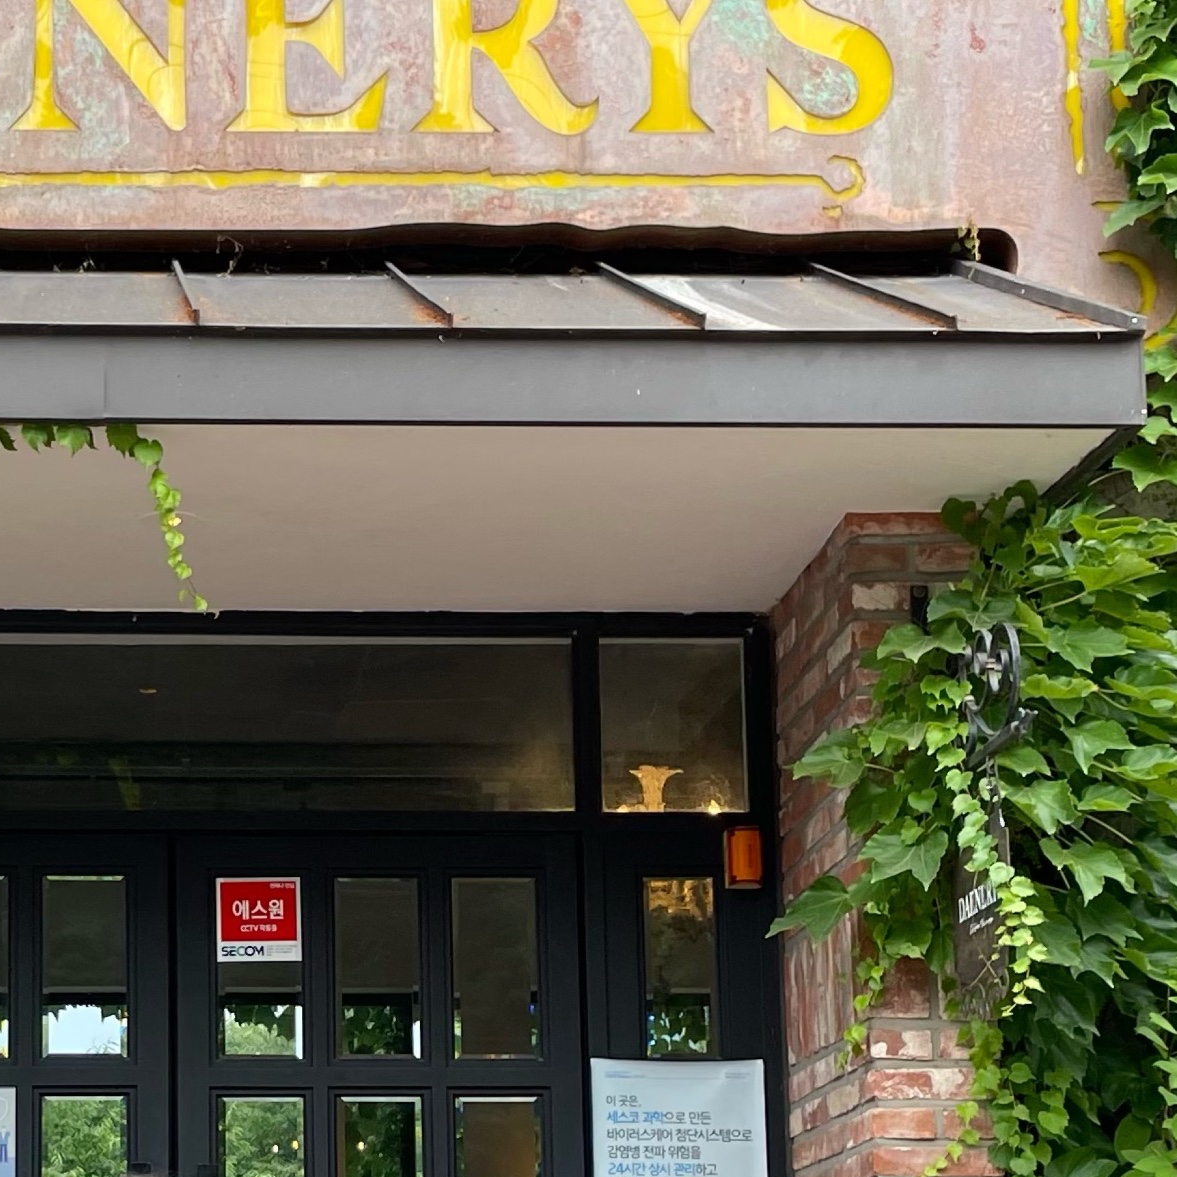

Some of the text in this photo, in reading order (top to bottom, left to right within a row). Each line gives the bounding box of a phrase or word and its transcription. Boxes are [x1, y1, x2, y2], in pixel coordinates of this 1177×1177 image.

[232, 899, 284, 920] 에스원
[240, 924, 259, 932] CCTV
[221, 945, 265, 957] SECOM
[606, 1095, 617, 1107] 이
[607, 1111, 712, 1125] 세스코 과학으로 만든
[607, 1128, 753, 1142] 바이러스케어 첨단시스템으로
[608, 1145, 701, 1160] 감염병 전파 위험을
[608, 1162, 718, 1177] 24시간 상시 관리하고
